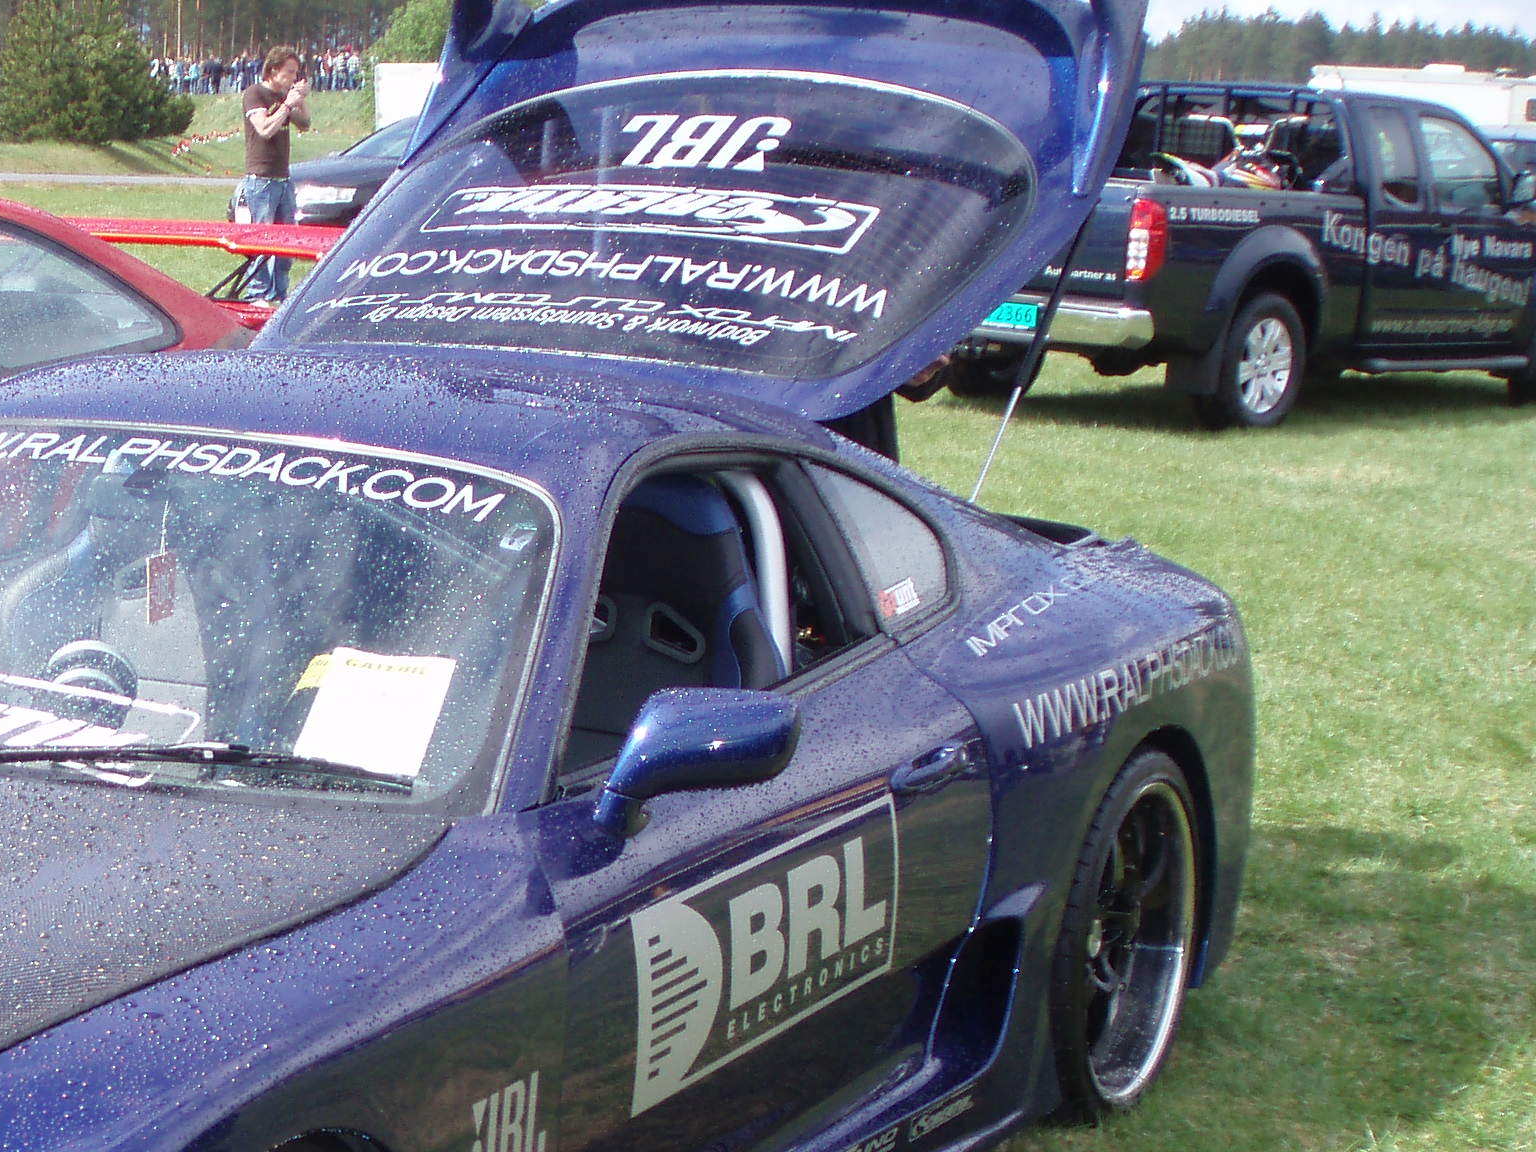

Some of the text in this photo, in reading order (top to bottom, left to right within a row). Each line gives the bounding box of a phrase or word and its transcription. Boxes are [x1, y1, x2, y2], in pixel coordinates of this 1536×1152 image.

[622, 113, 792, 172] JBL
[1170, 205, 1261, 223] 2.5 TURBODIESEL
[1323, 209, 1411, 267] Kongen
[1416, 245, 1445, 278] på
[1044, 264, 1102, 280] Autartner
[1485, 235, 1533, 259] Navara
[336, 249, 888, 319] WWW.RALPHSDACK.COM
[361, 303, 771, 346] Bodywork & Soundsystem Design By
[728, 836, 887, 1010] BRL
[726, 935, 888, 1040] ELECTRONICS
